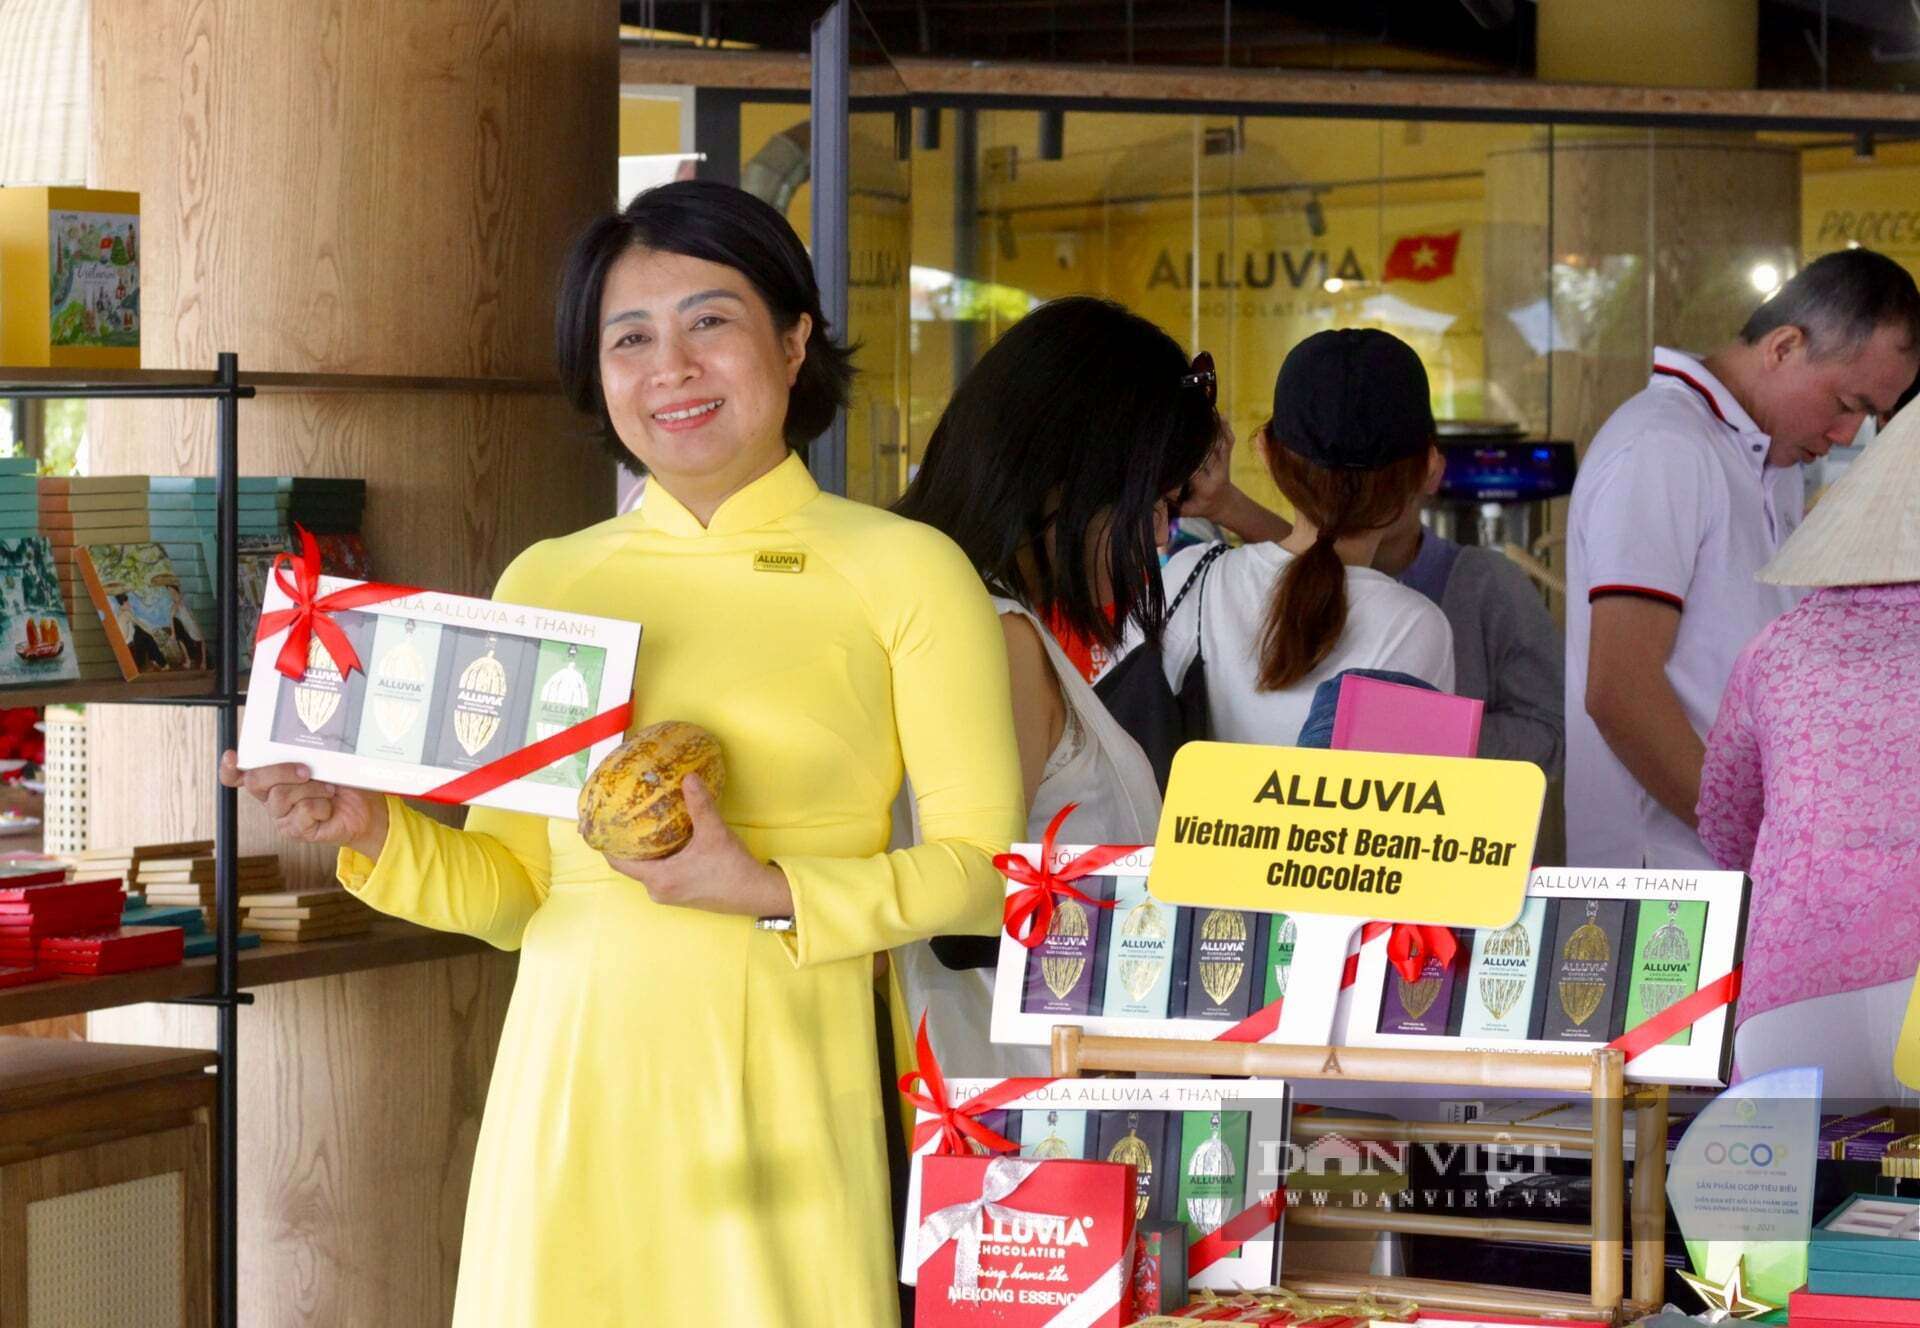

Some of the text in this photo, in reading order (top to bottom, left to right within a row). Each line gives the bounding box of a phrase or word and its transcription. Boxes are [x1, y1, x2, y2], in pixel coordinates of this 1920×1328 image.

[1146, 247, 1365, 291] ALLUVIA
[757, 555, 799, 565] ALLUVIA
[432, 602, 509, 624] ALLUVIA
[534, 615, 598, 639] THANH
[378, 679, 423, 692] ALLUVIA
[1253, 769, 1446, 816] ALLUVIA
[1173, 815, 1517, 867] Vietnam best Bean-to-Bar
[1266, 861, 1403, 895] chocolate
[1533, 875, 1698, 892] ALLUVIA 4 THANH
[1121, 939, 1165, 949] ALLUVIA
[1200, 941, 1244, 952] ALLUVIA
[1483, 957, 1528, 968] ALLUVIA
[1561, 962, 1608, 972] ALLUVIA
[1643, 962, 1690, 972] ALLUVIA
[1078, 1087, 1153, 1101] ALLUVIA
[1159, 1087, 1170, 1101] 4
[1176, 1088, 1239, 1102] THANH
[1704, 1141, 1789, 1168] OCOP
[1190, 1175, 1234, 1185] ALLUVIA
[977, 1244, 1066, 1259] HOCOLATIER
[976, 1263, 1010, 1289] ring
[1045, 1264, 1070, 1282] the
[1019, 1289, 1080, 1306] ESSENC
